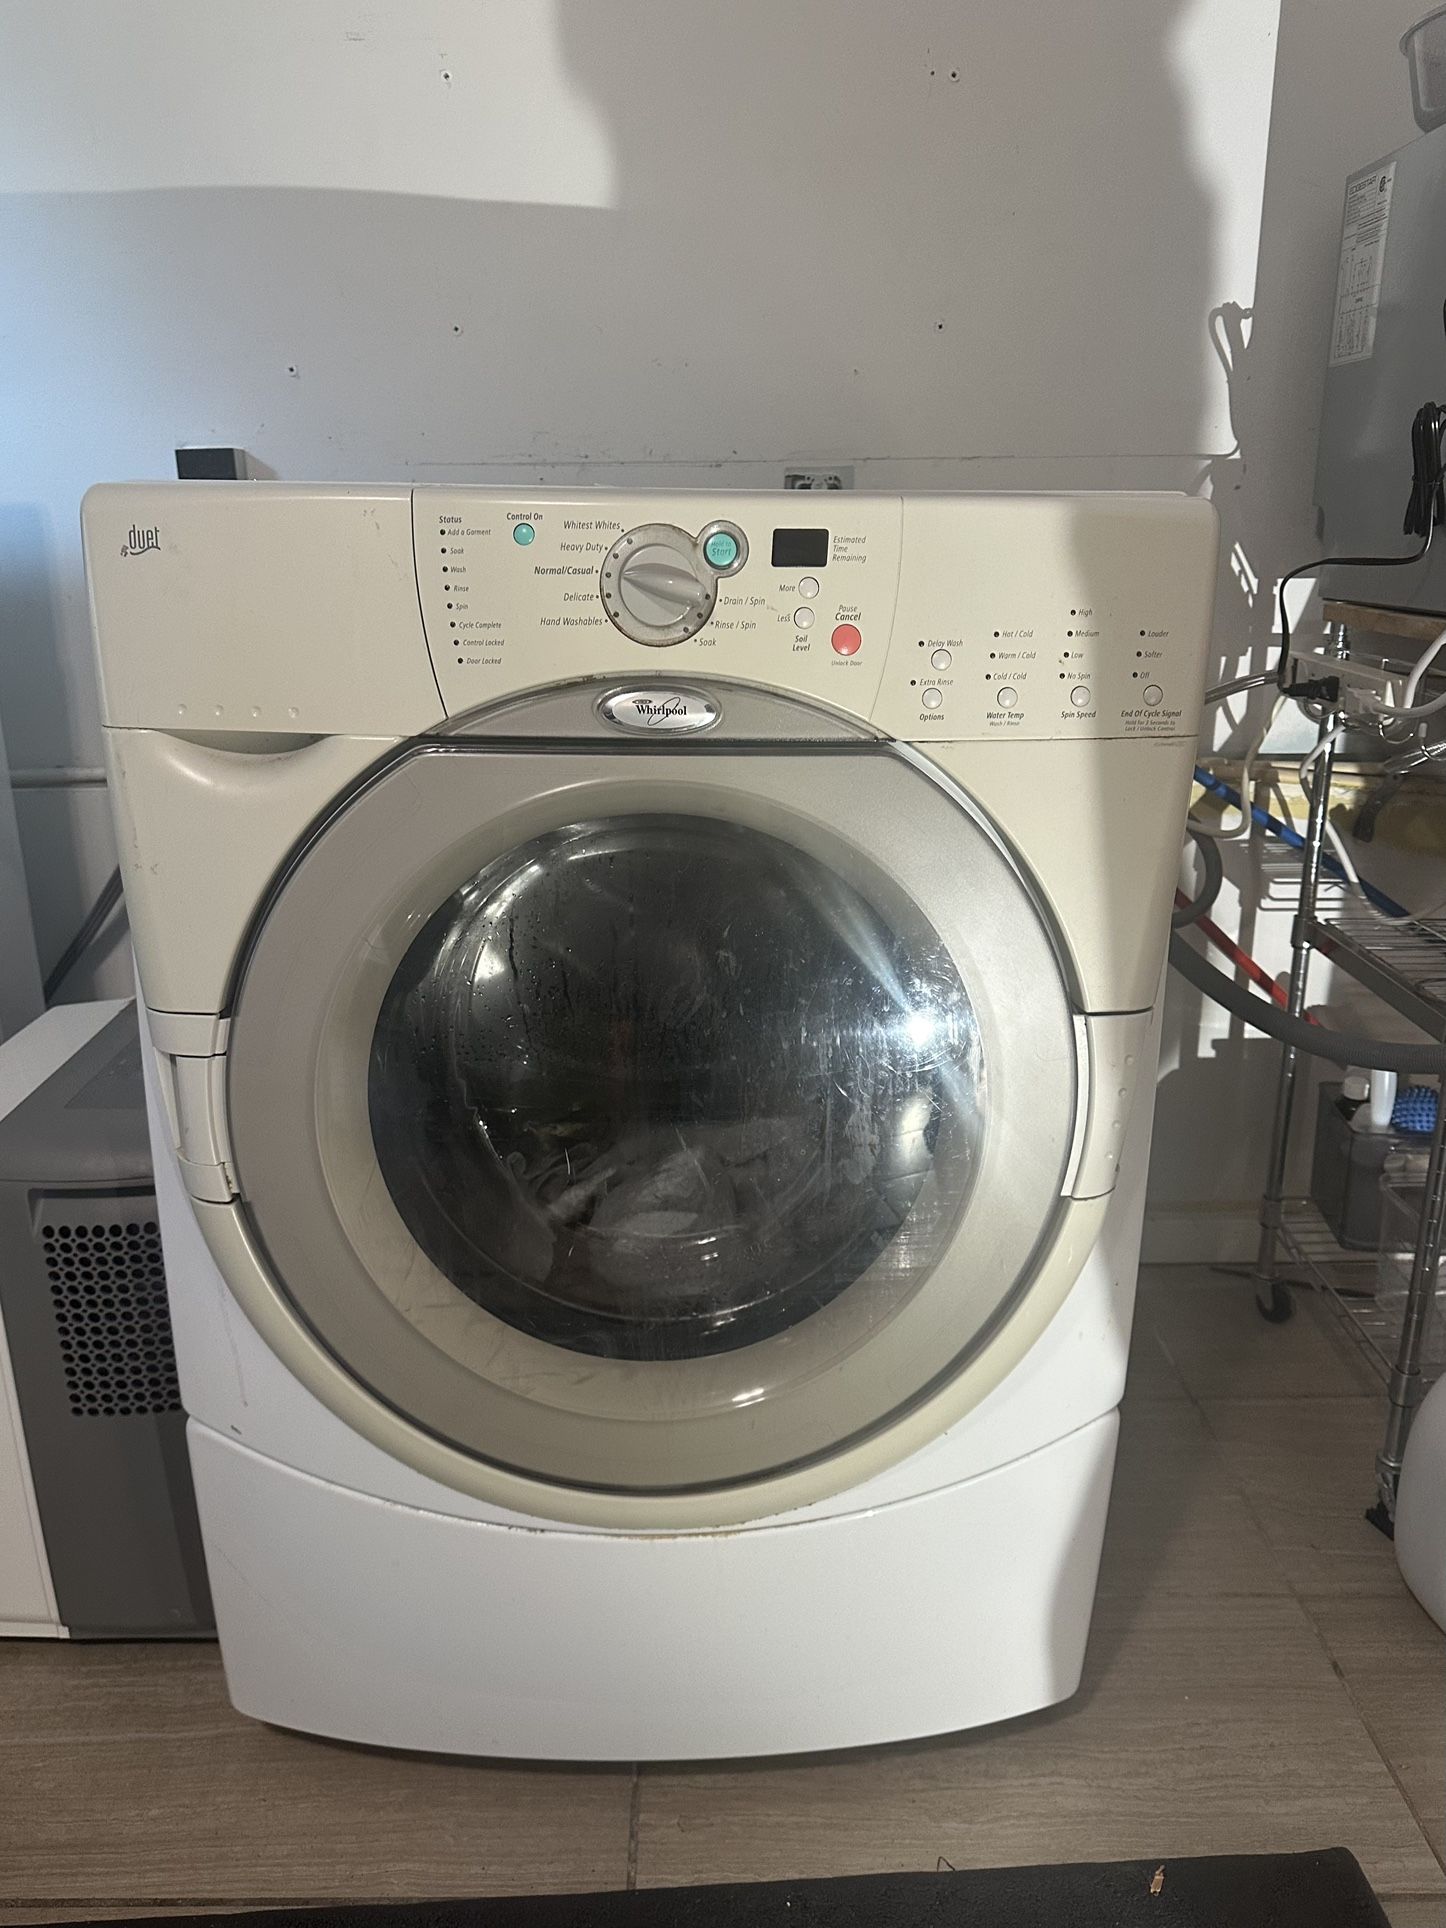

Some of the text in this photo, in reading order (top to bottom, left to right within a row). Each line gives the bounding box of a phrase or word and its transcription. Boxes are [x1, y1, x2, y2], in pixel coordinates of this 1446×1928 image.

[439, 515, 462, 523] Status
[506, 512, 543, 520] Control On
[563, 521, 621, 530] Whitest Whites
[447, 528, 460, 536] Add
[466, 528, 491, 536] Garment
[129, 524, 160, 550] duet
[832, 535, 867, 544] Estimated
[560, 542, 604, 553] Heavy Duty
[711, 548, 732, 556] Start
[832, 544, 848, 552] Time
[831, 553, 867, 563] Remaining
[534, 565, 594, 575] Normal/Casual
[779, 584, 796, 592] More
[563, 592, 594, 601] Delicate
[723, 596, 766, 607] Drain / Spin
[456, 602, 469, 611] Spin
[838, 604, 858, 612] Pause
[835, 612, 862, 621] Cancel
[1078, 608, 1093, 617] High
[540, 616, 603, 626] Hand Washables
[777, 614, 791, 622] Less
[458, 621, 502, 630] Cycle Complete
[714, 620, 757, 630] Rinse / Spin
[1002, 629, 1034, 638] Hot / Cold
[1074, 630, 1100, 638] Medium
[699, 638, 717, 646] Soak
[795, 635, 808, 643] Soil
[792, 643, 811, 652] Level
[927, 639, 964, 649] Delay Wash
[998, 650, 1037, 659] Warm / Cold
[1070, 651, 1084, 659] Low
[1143, 650, 1163, 658] Softer
[993, 672, 1008, 680] Cold
[1012, 672, 1027, 680] Cold
[1077, 672, 1091, 681] Spin
[1140, 671, 1150, 679] Off
[919, 678, 954, 686] Extra Rinse
[635, 704, 687, 717] Whirlpool
[1060, 710, 1097, 720] Spin Speed
[1134, 709, 1143, 717] Of
[1143, 709, 1161, 718] Cycle
[1161, 709, 1182, 719] Signal
[919, 712, 945, 722] Options
[986, 711, 1025, 720] Water Temp
